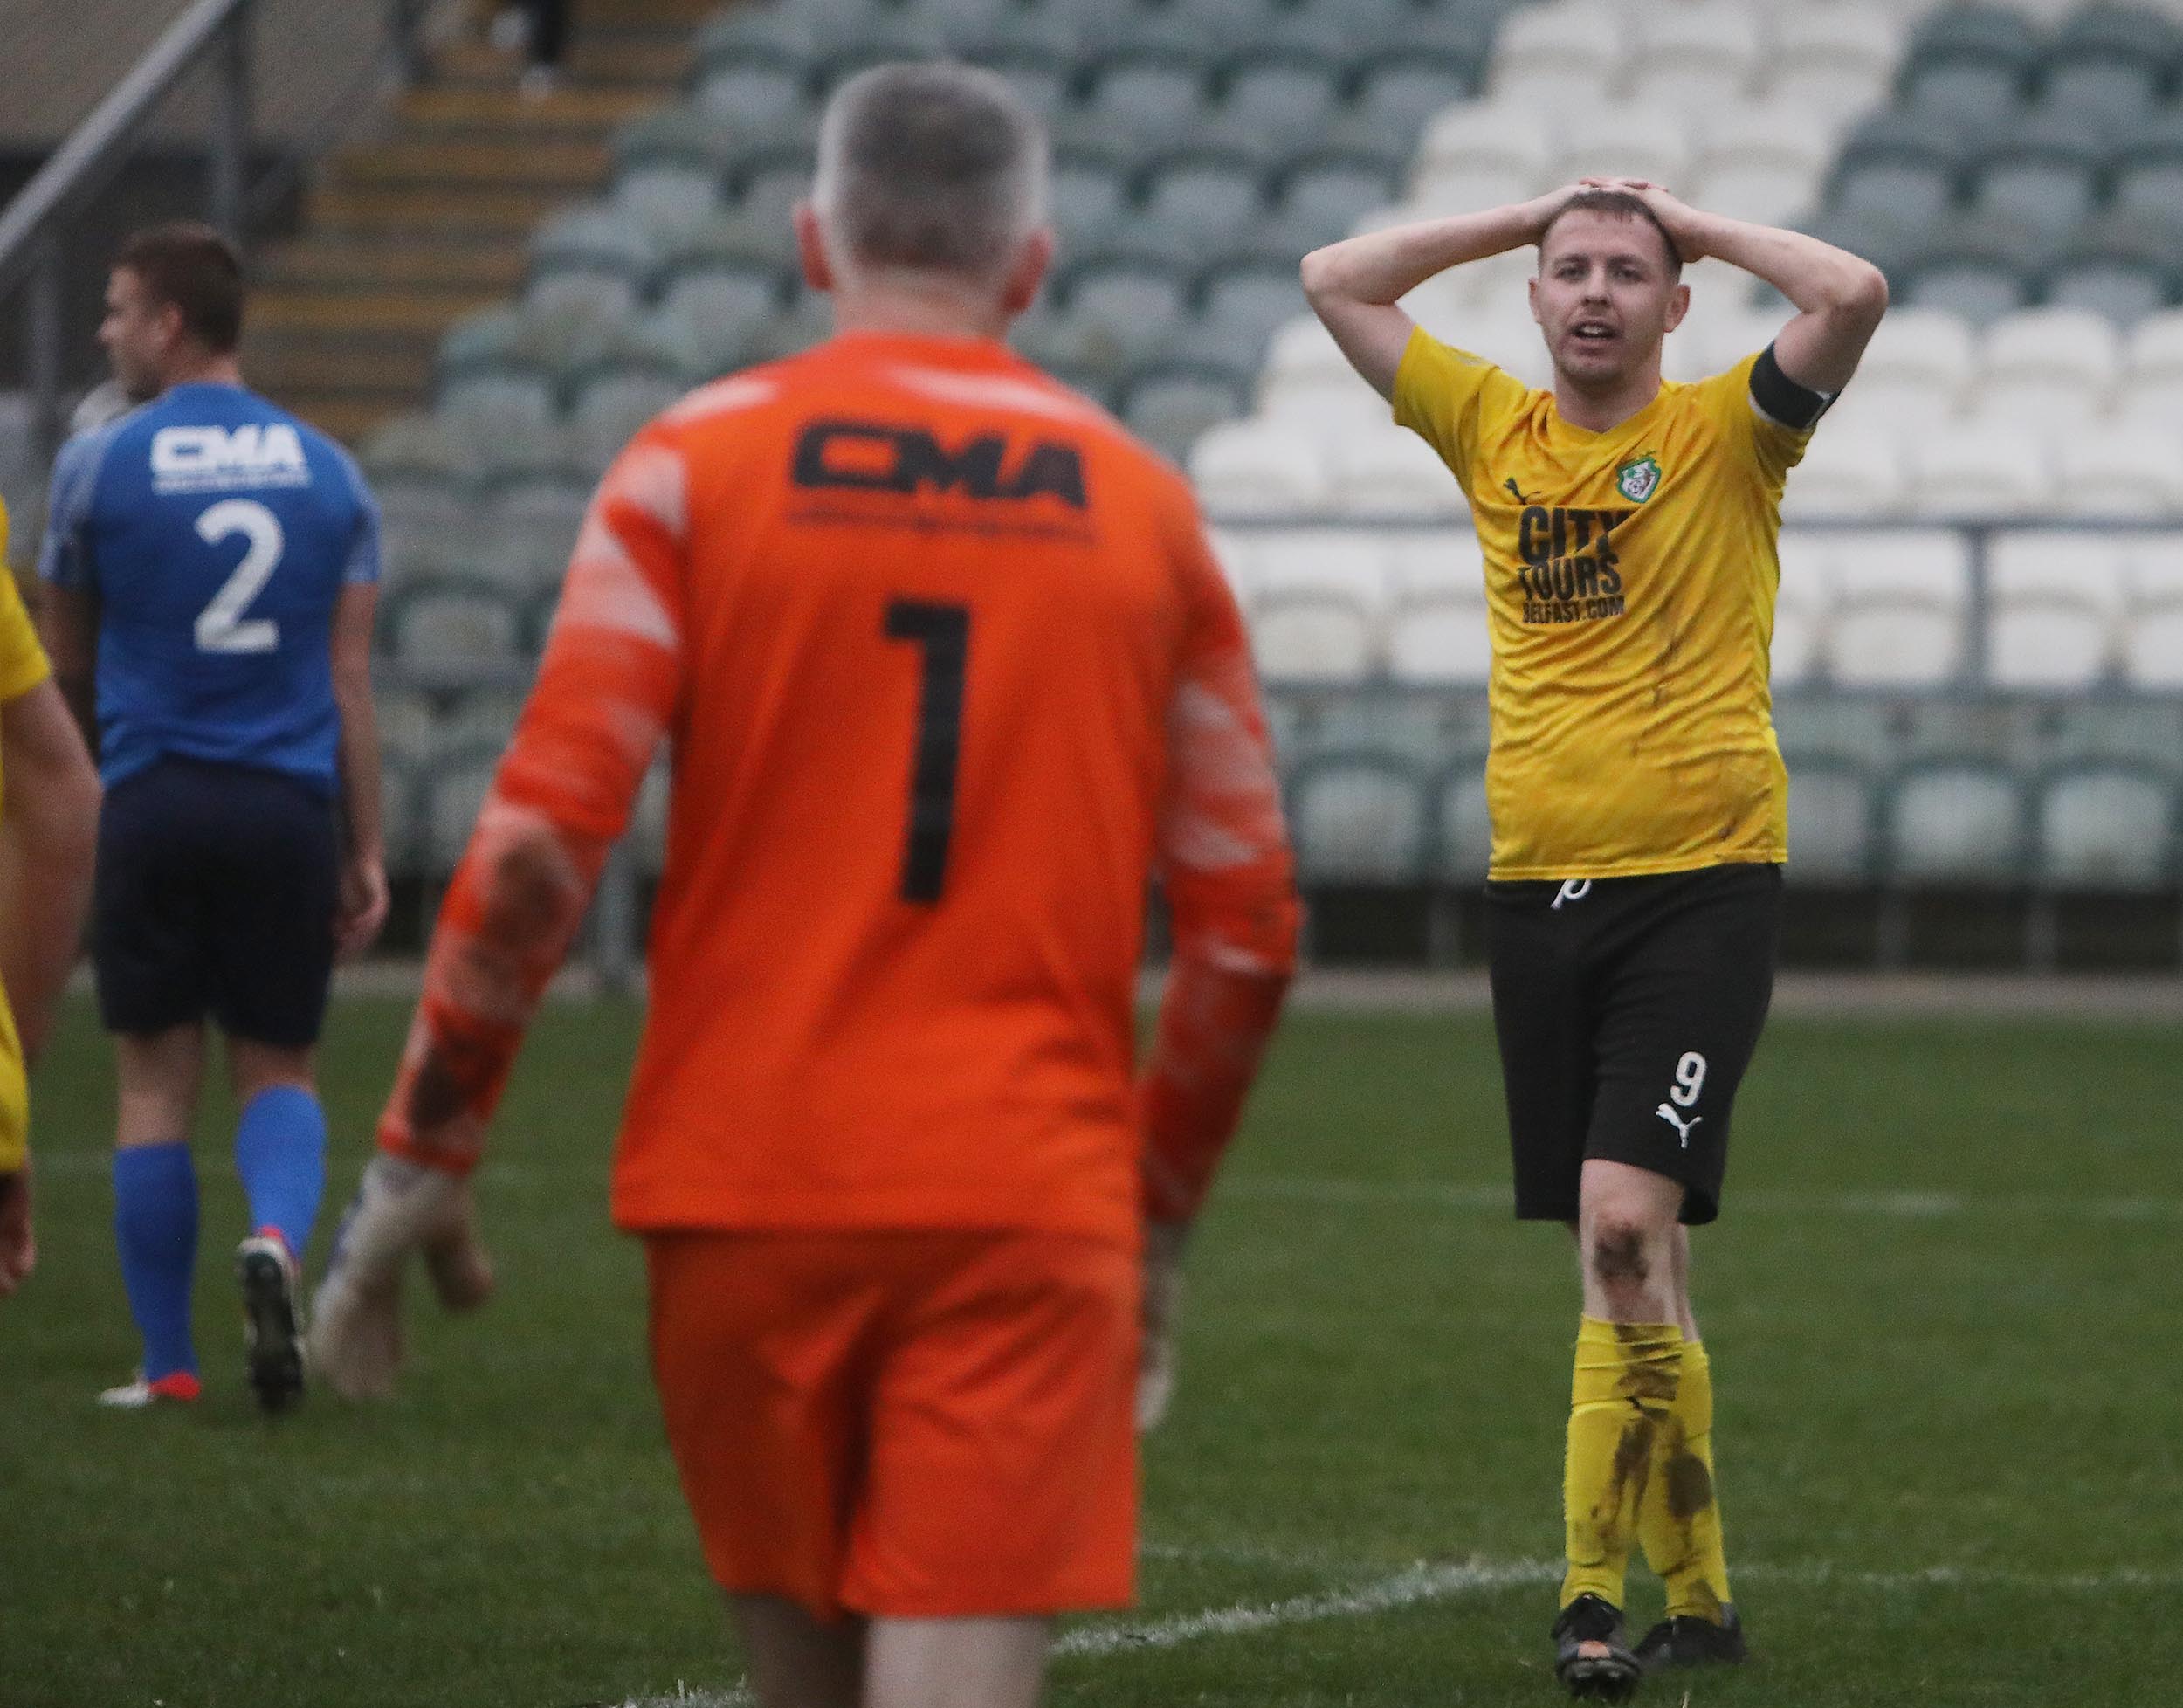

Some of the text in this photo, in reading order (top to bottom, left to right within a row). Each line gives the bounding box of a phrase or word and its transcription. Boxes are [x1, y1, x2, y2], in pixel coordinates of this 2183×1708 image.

[150, 423, 306, 472] CMA
[793, 419, 1087, 510] CMA
[1518, 506, 1638, 565] CITY
[194, 497, 286, 655] 2
[1518, 553, 1622, 602] TOURS
[884, 599, 970, 904] 1
[1670, 1050, 1708, 1108] 9
